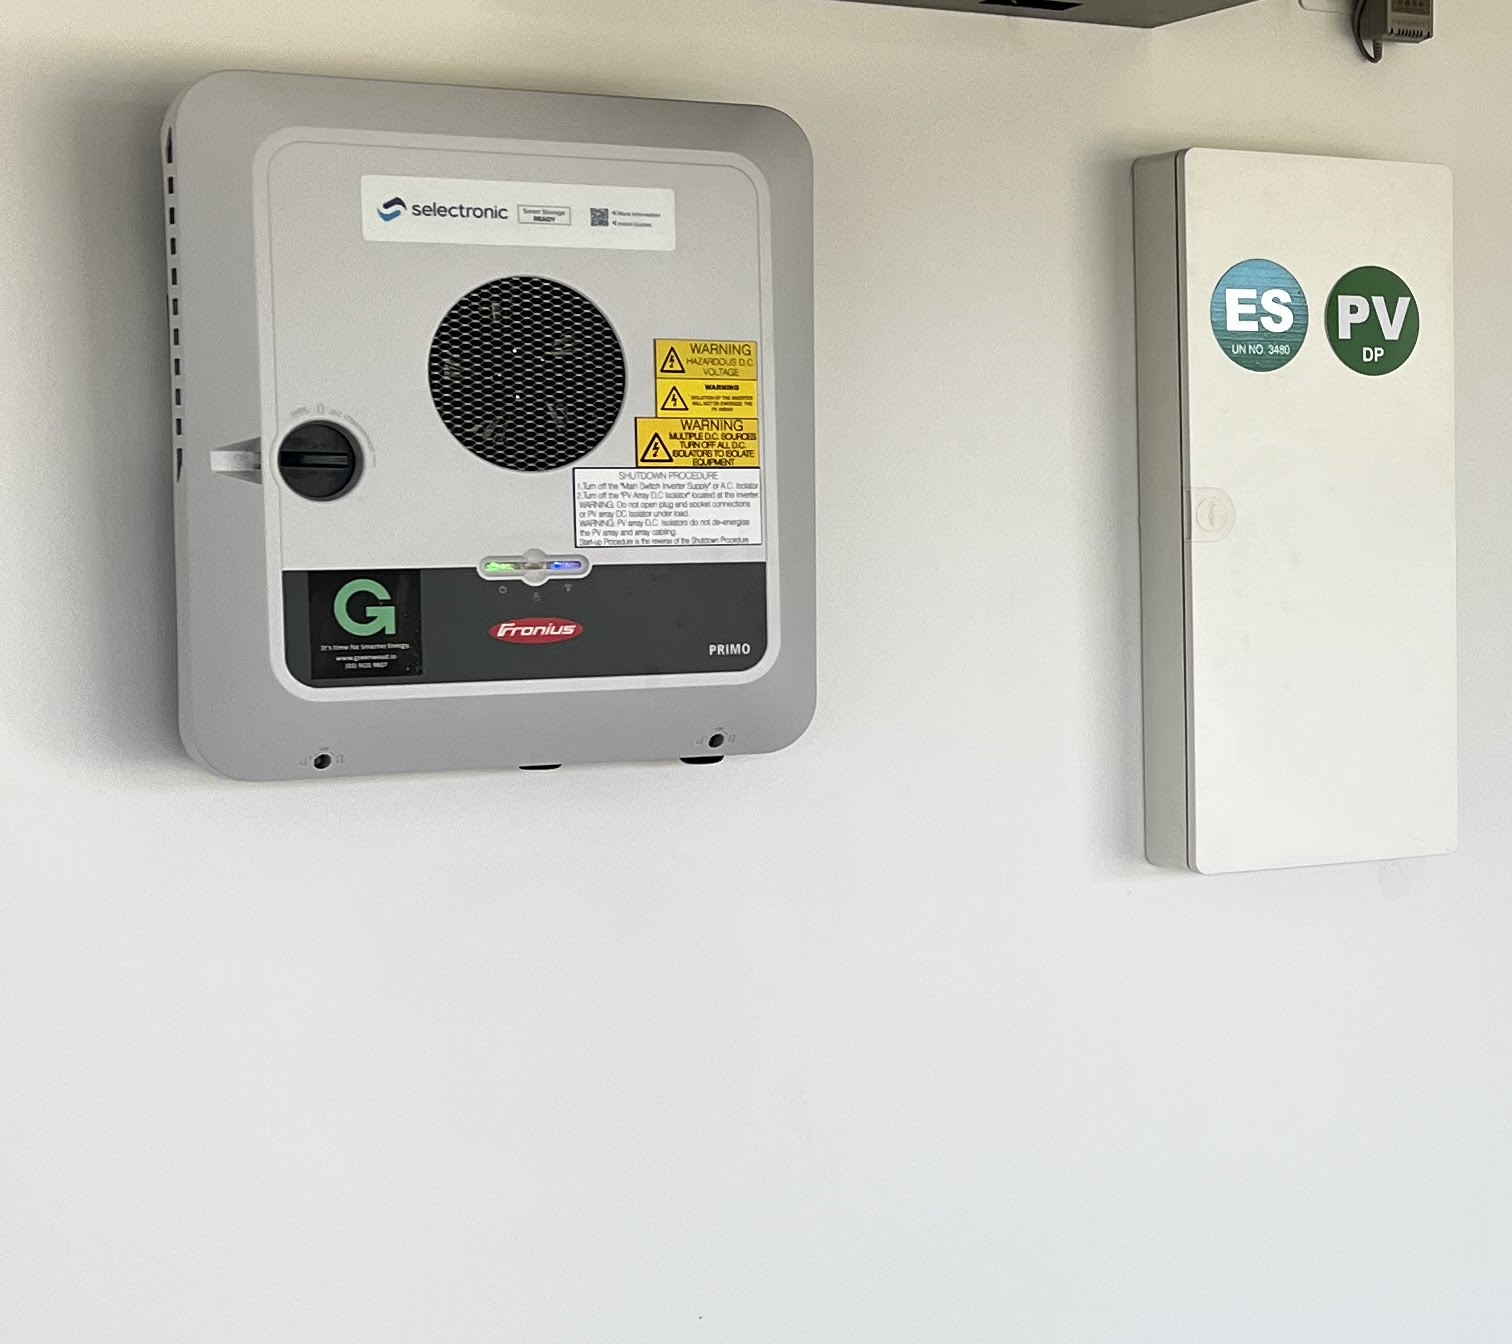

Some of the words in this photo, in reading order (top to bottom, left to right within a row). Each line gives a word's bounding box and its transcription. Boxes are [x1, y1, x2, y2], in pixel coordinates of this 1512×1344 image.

[411, 202, 509, 220] selectronic
[1225, 288, 1294, 333] ES
[1337, 295, 1411, 341] PV
[690, 343, 752, 355] WARNING
[1231, 344, 1247, 354] UN
[1268, 344, 1290, 355] 3480
[1363, 347, 1384, 363] DP
[687, 358, 736, 366] HAZARDOUS
[703, 368, 739, 376] VOLTAGE
[681, 420, 743, 431] WARNING
[669, 472, 718, 480] PROCEDURE
[497, 622, 576, 638] Fronius
[709, 643, 751, 656] PRIMO
